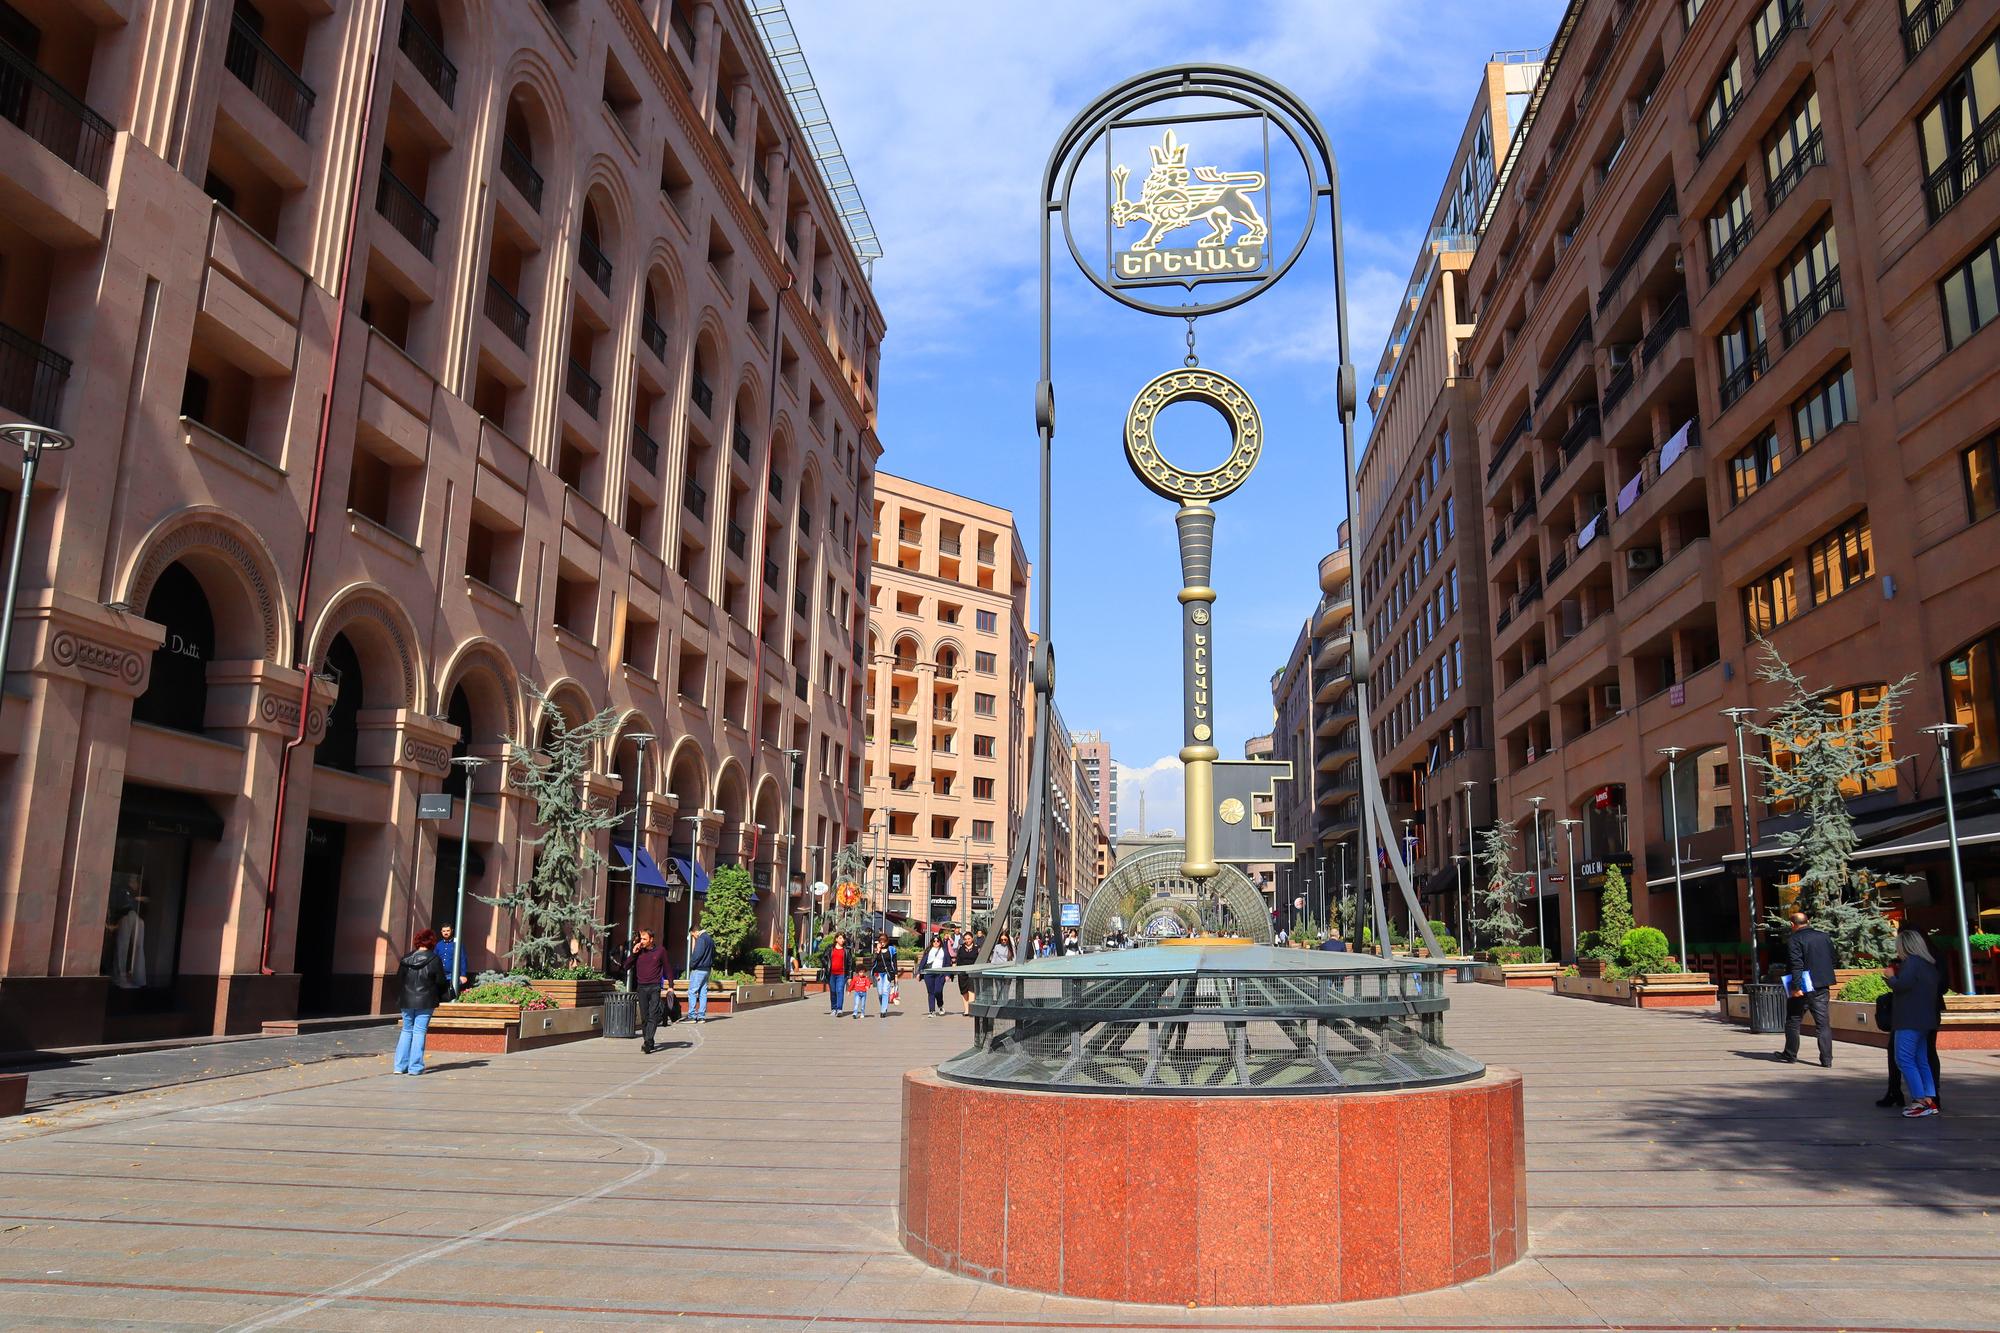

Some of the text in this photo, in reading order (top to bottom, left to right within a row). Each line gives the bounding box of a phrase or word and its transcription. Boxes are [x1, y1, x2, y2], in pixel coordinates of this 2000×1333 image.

[1123, 247, 1256, 275] ԵՐԵՎԱՆ
[170, 634, 200, 660] Dutti
[1194, 633, 1207, 719] ԵՐԵՎԱՆ
[1581, 862, 1596, 876] COLE
